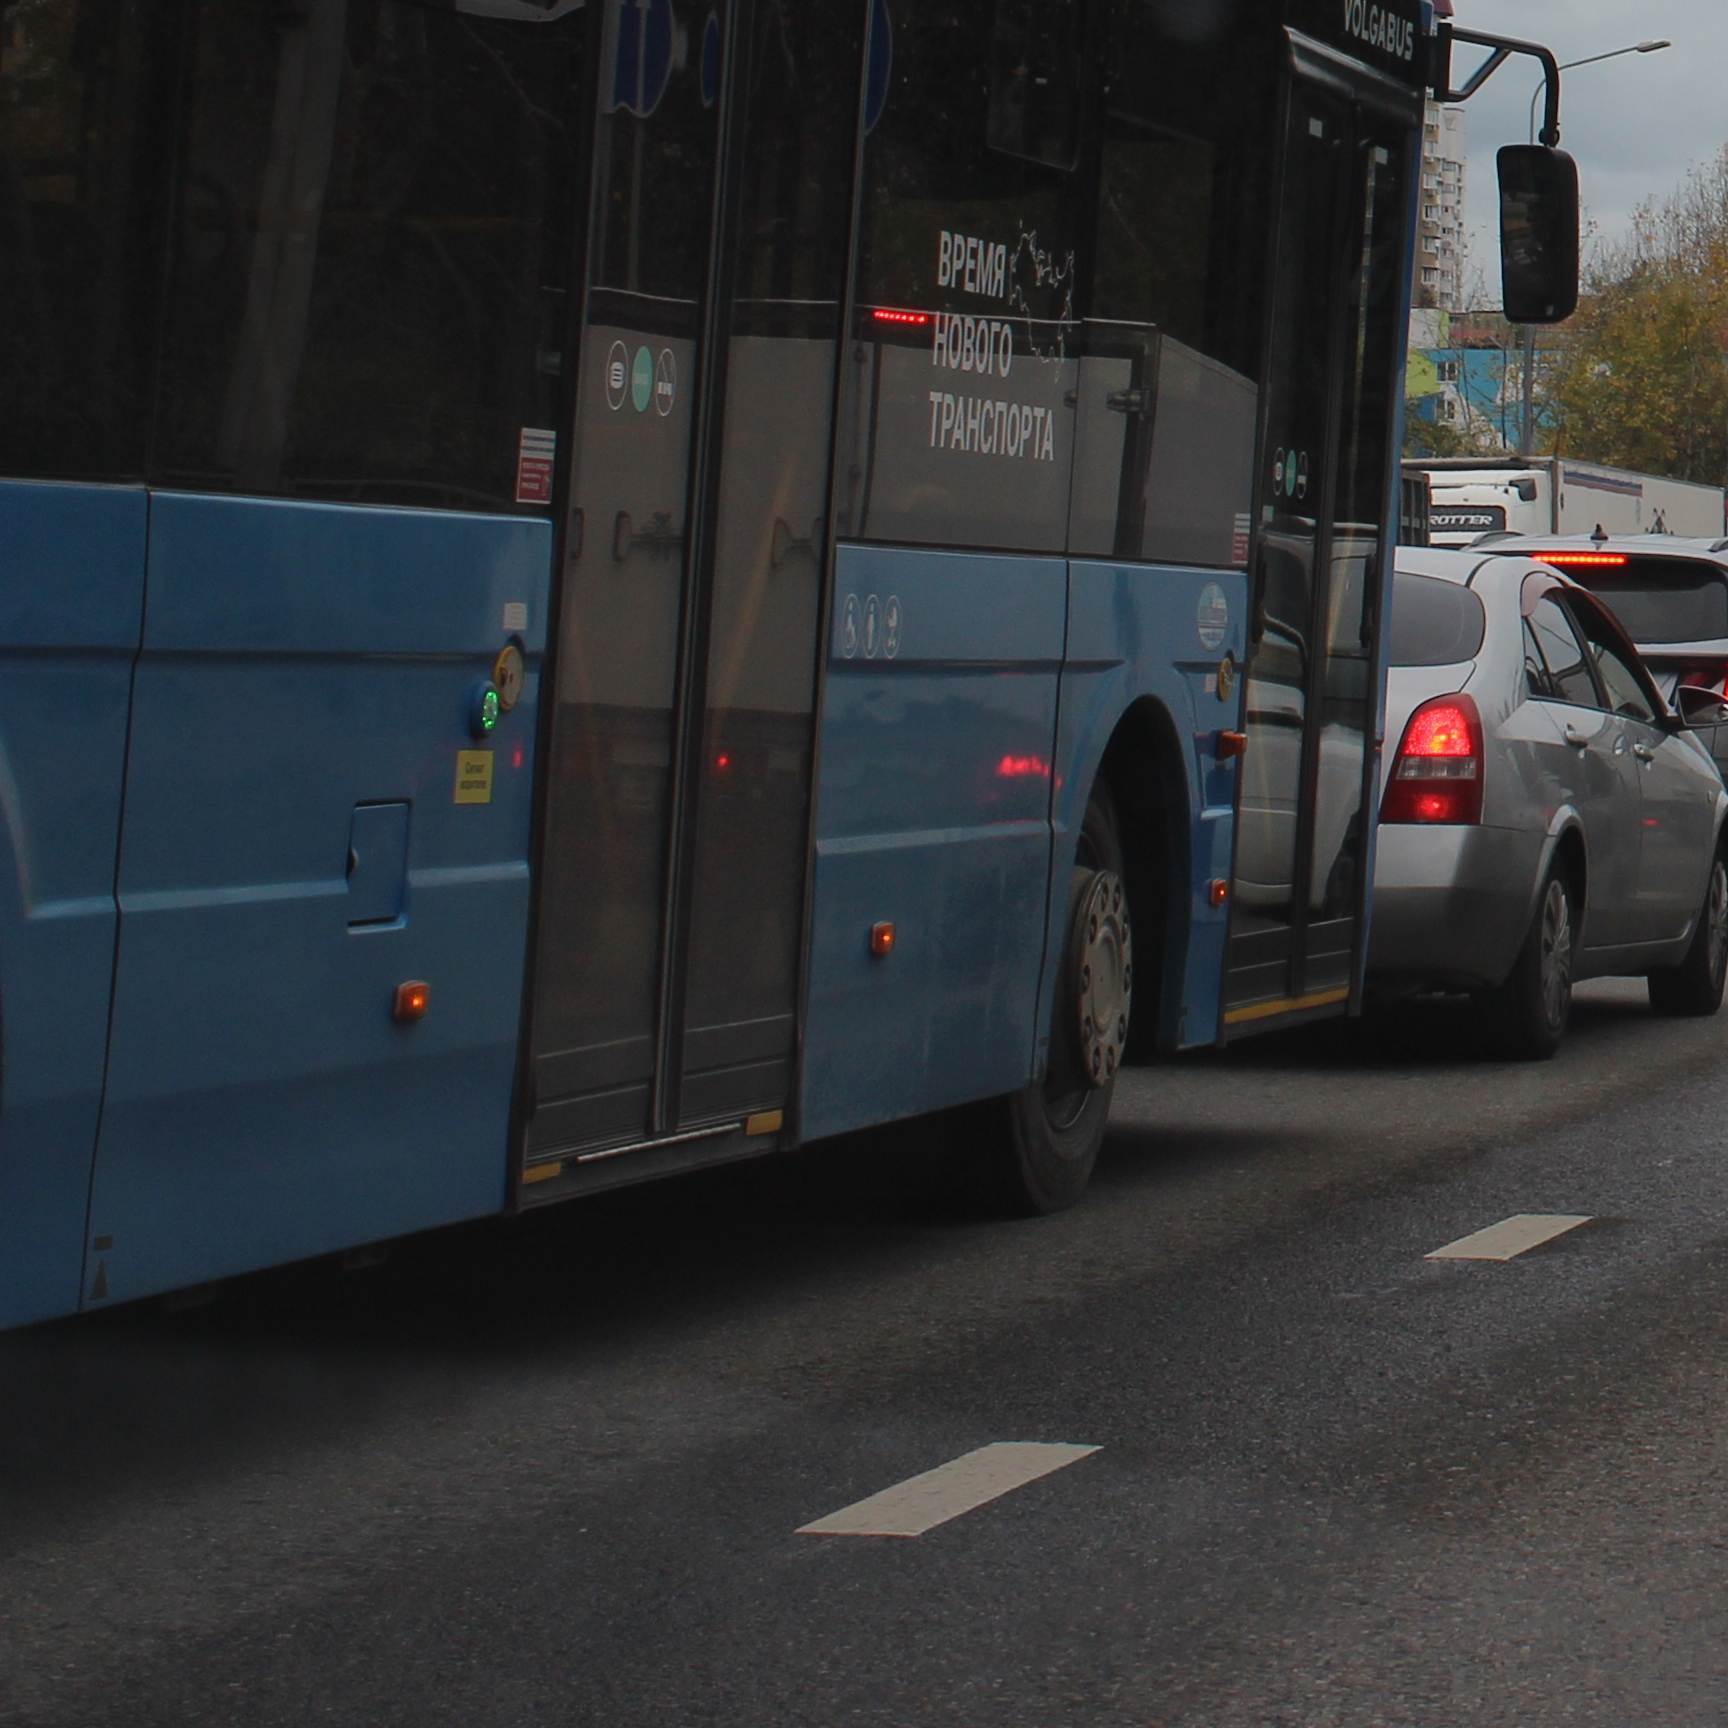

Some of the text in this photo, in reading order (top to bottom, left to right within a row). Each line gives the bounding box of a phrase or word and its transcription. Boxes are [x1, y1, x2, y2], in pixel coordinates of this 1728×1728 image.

[937, 229, 1007, 299] ВРЕМЯ
[932, 310, 1013, 379] НОВОГО
[928, 390, 1055, 462] ТРАНСПОРТА
